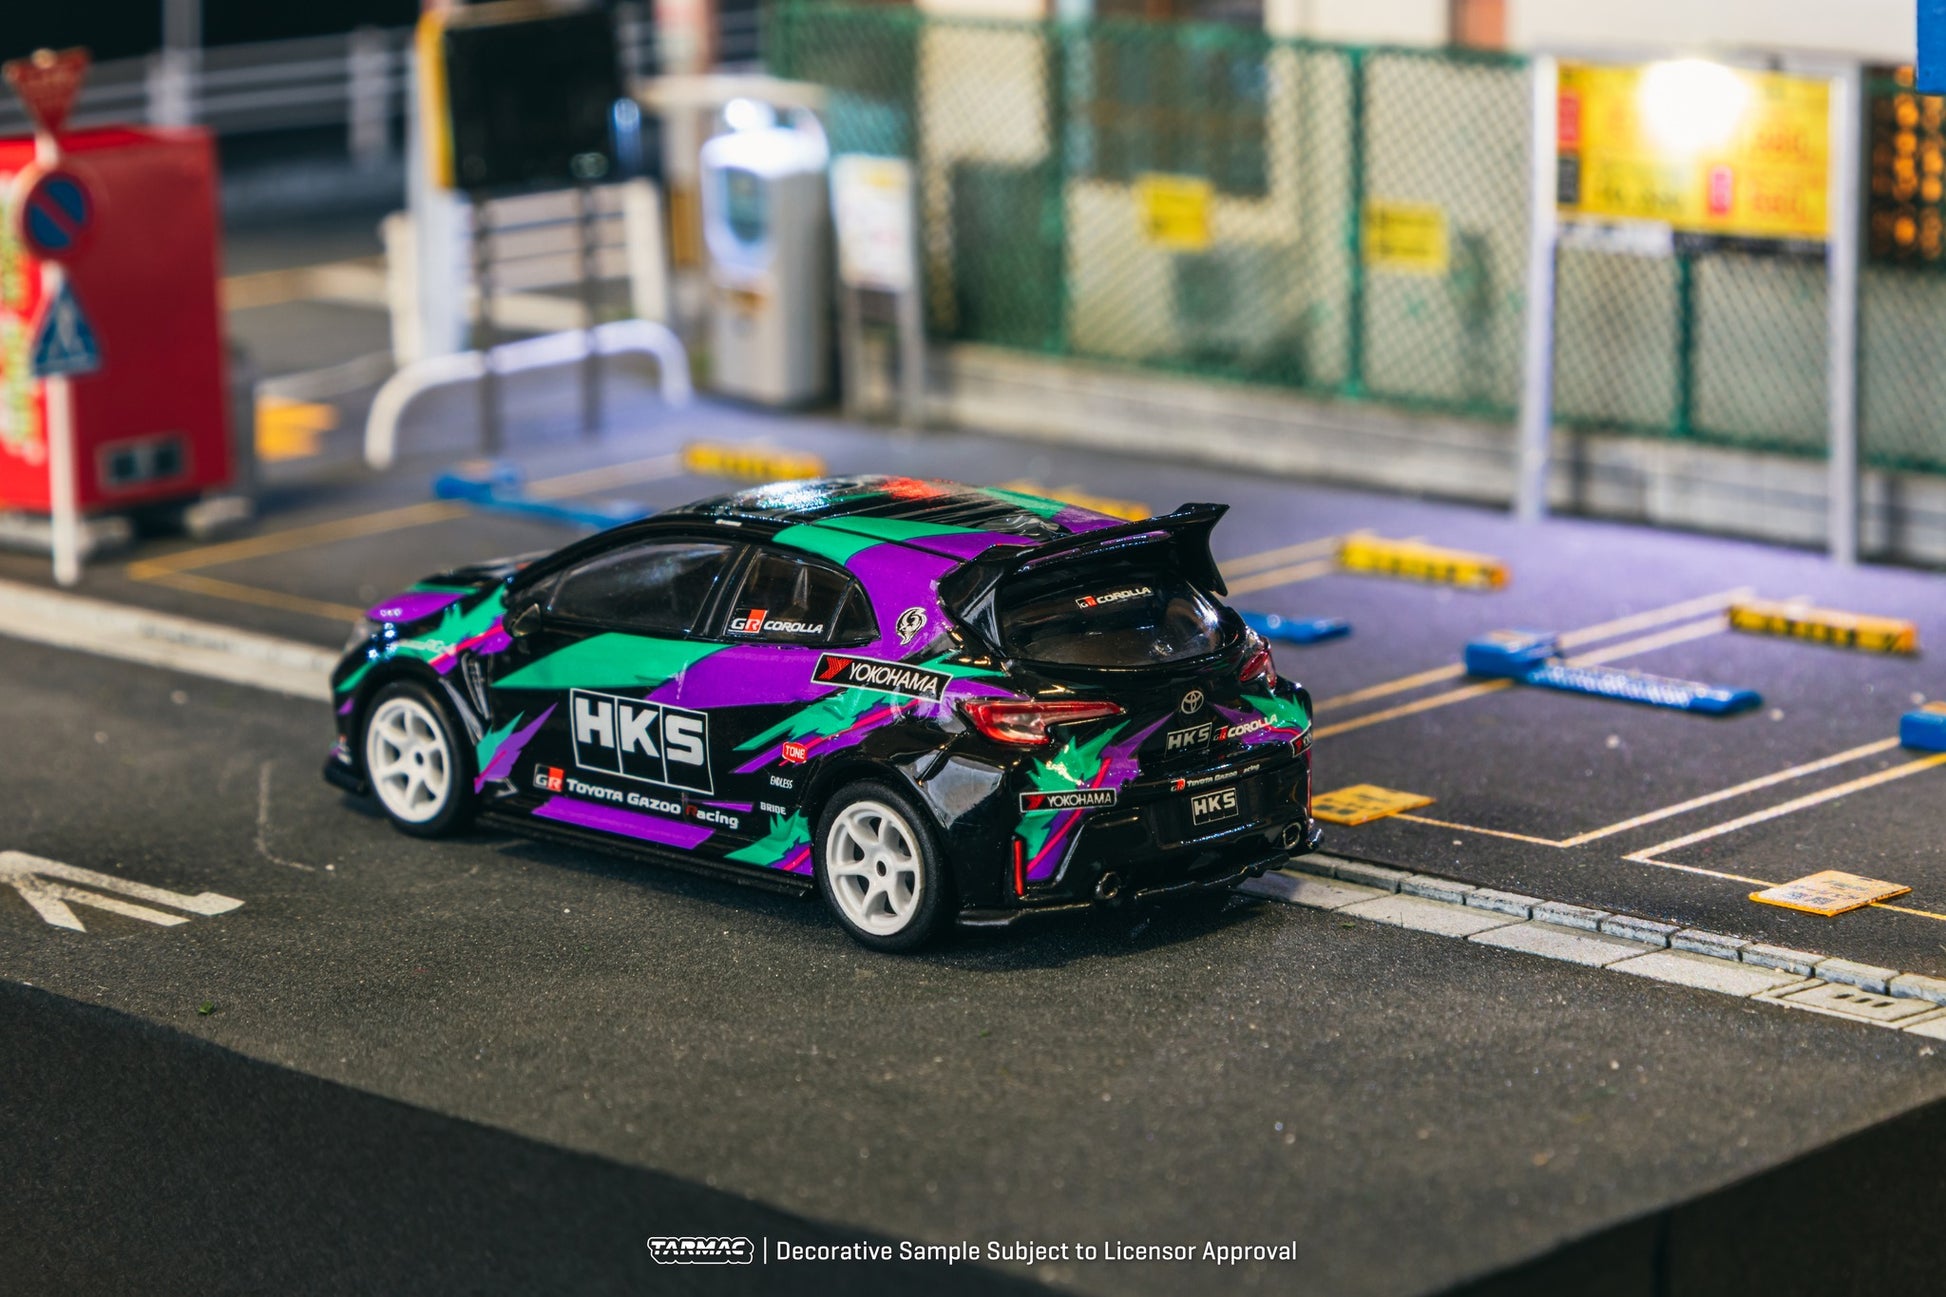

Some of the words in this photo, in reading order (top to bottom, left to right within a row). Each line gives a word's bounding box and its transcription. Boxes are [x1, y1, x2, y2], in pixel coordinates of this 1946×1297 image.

[1096, 587, 1151, 604] COROLLA
[764, 620, 823, 633] COROLLA
[849, 662, 938, 693] YOKOHAMA
[575, 697, 704, 766] HKS
[1227, 714, 1278, 738] COROLLA
[1167, 726, 1210, 750] HKS
[785, 744, 806, 760] TONE
[770, 775, 793, 789] ENDLESS
[534, 773, 563, 791] GR
[566, 778, 623, 801] TOYOTA
[685, 804, 739, 829] Racing
[760, 801, 787, 815] BRIDE
[1047, 792, 1112, 807] YOKOHAMA
[1193, 791, 1236, 816] HKS
